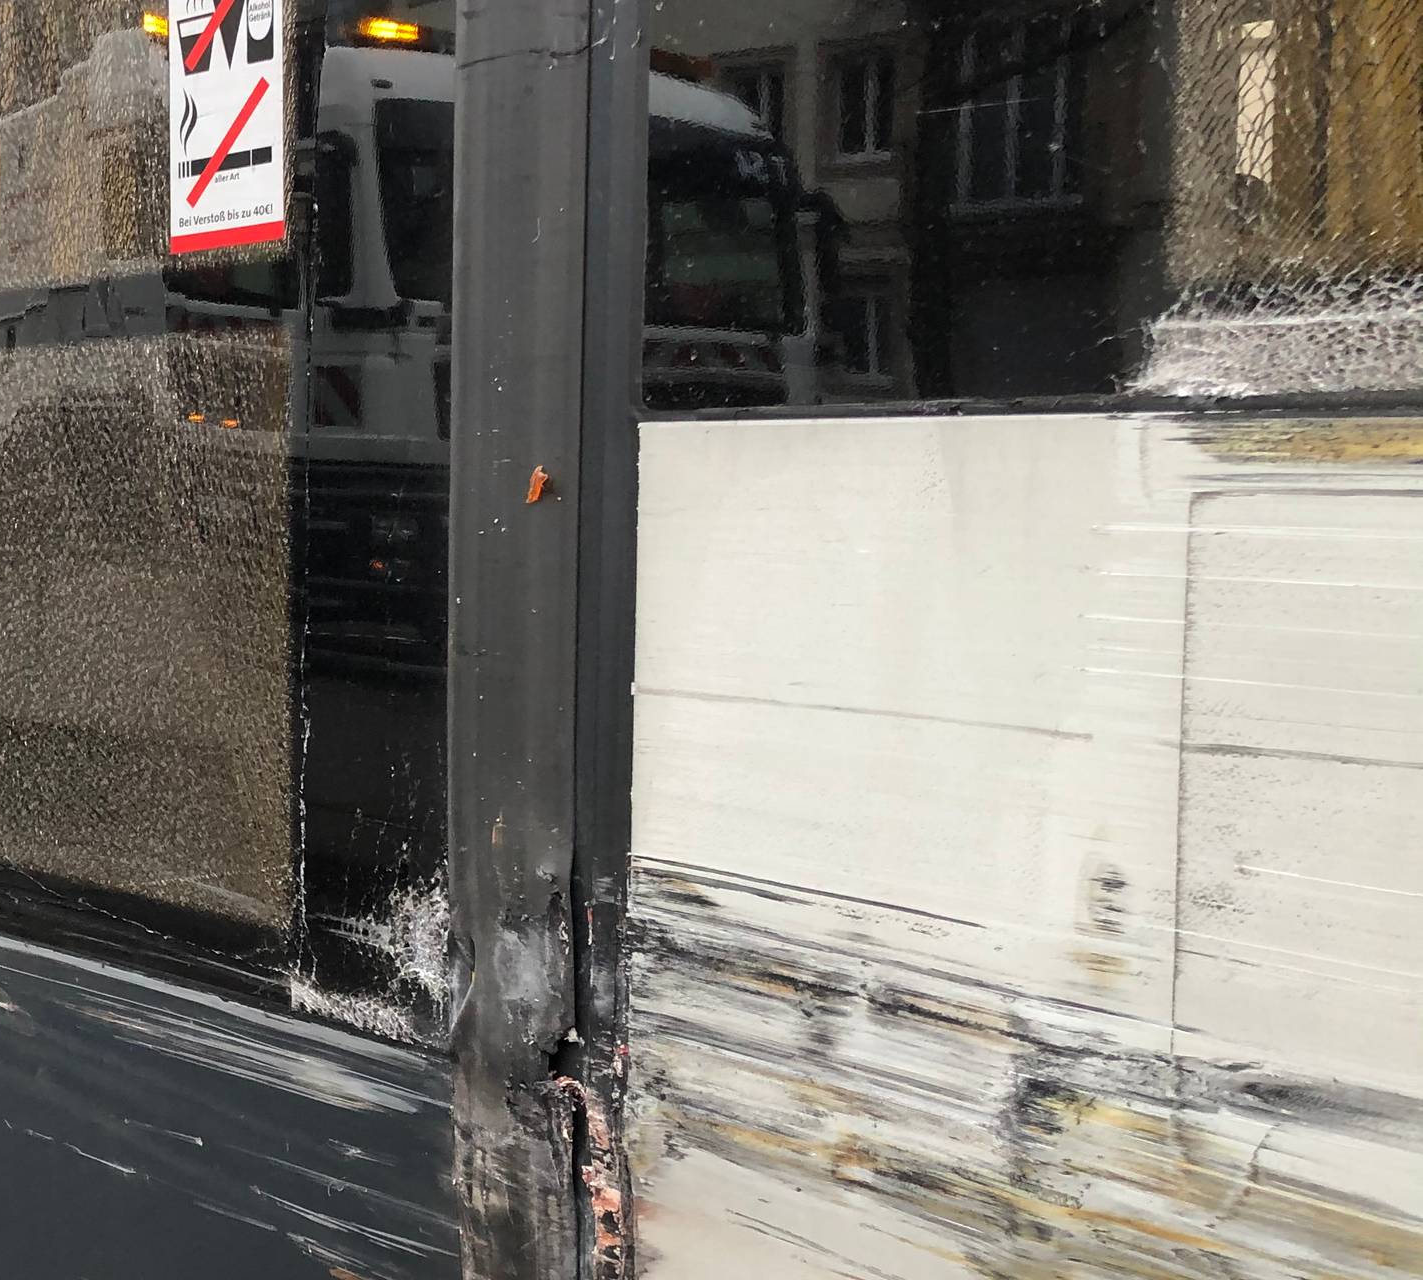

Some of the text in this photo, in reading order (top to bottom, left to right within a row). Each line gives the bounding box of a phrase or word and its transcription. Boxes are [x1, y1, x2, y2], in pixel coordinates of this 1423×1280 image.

[215, 174, 228, 183] aller
[179, 203, 273, 228] Bei Verstoß bis zu 40€!
